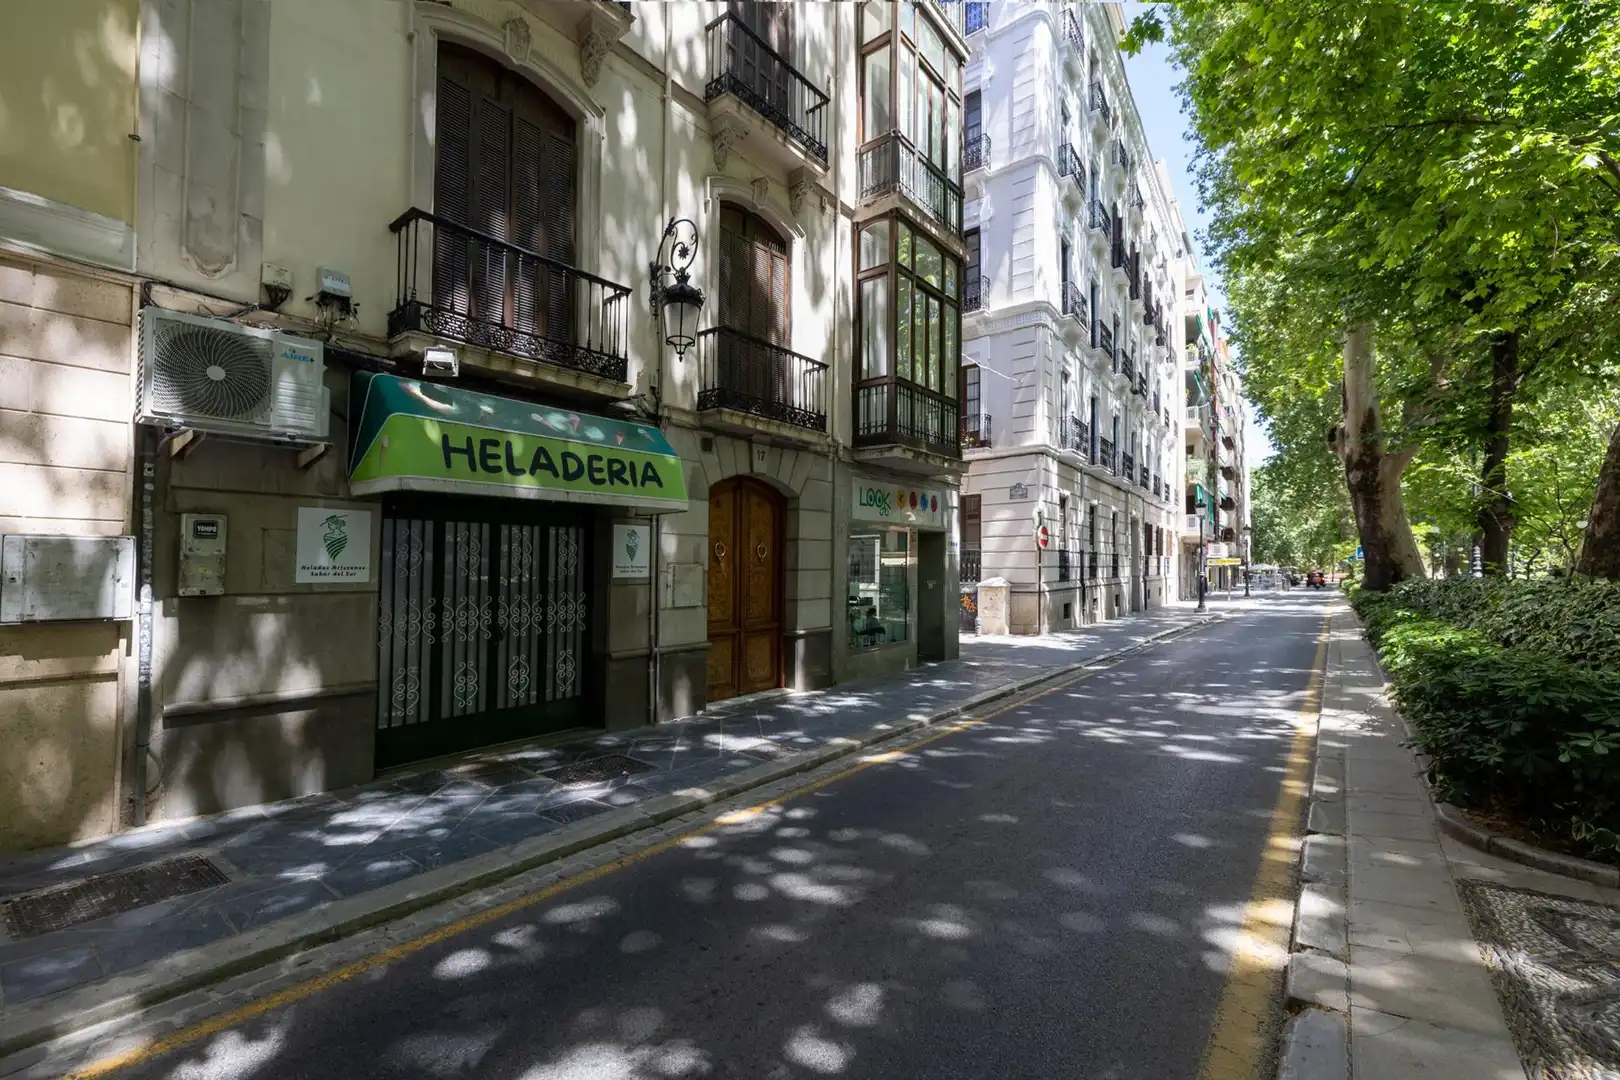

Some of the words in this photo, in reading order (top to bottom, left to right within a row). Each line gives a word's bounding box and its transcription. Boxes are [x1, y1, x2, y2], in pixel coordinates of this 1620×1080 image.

[442, 433, 664, 488] HELADERIA
[757, 449, 766, 461] 17
[860, 486, 892, 511] LOOK
